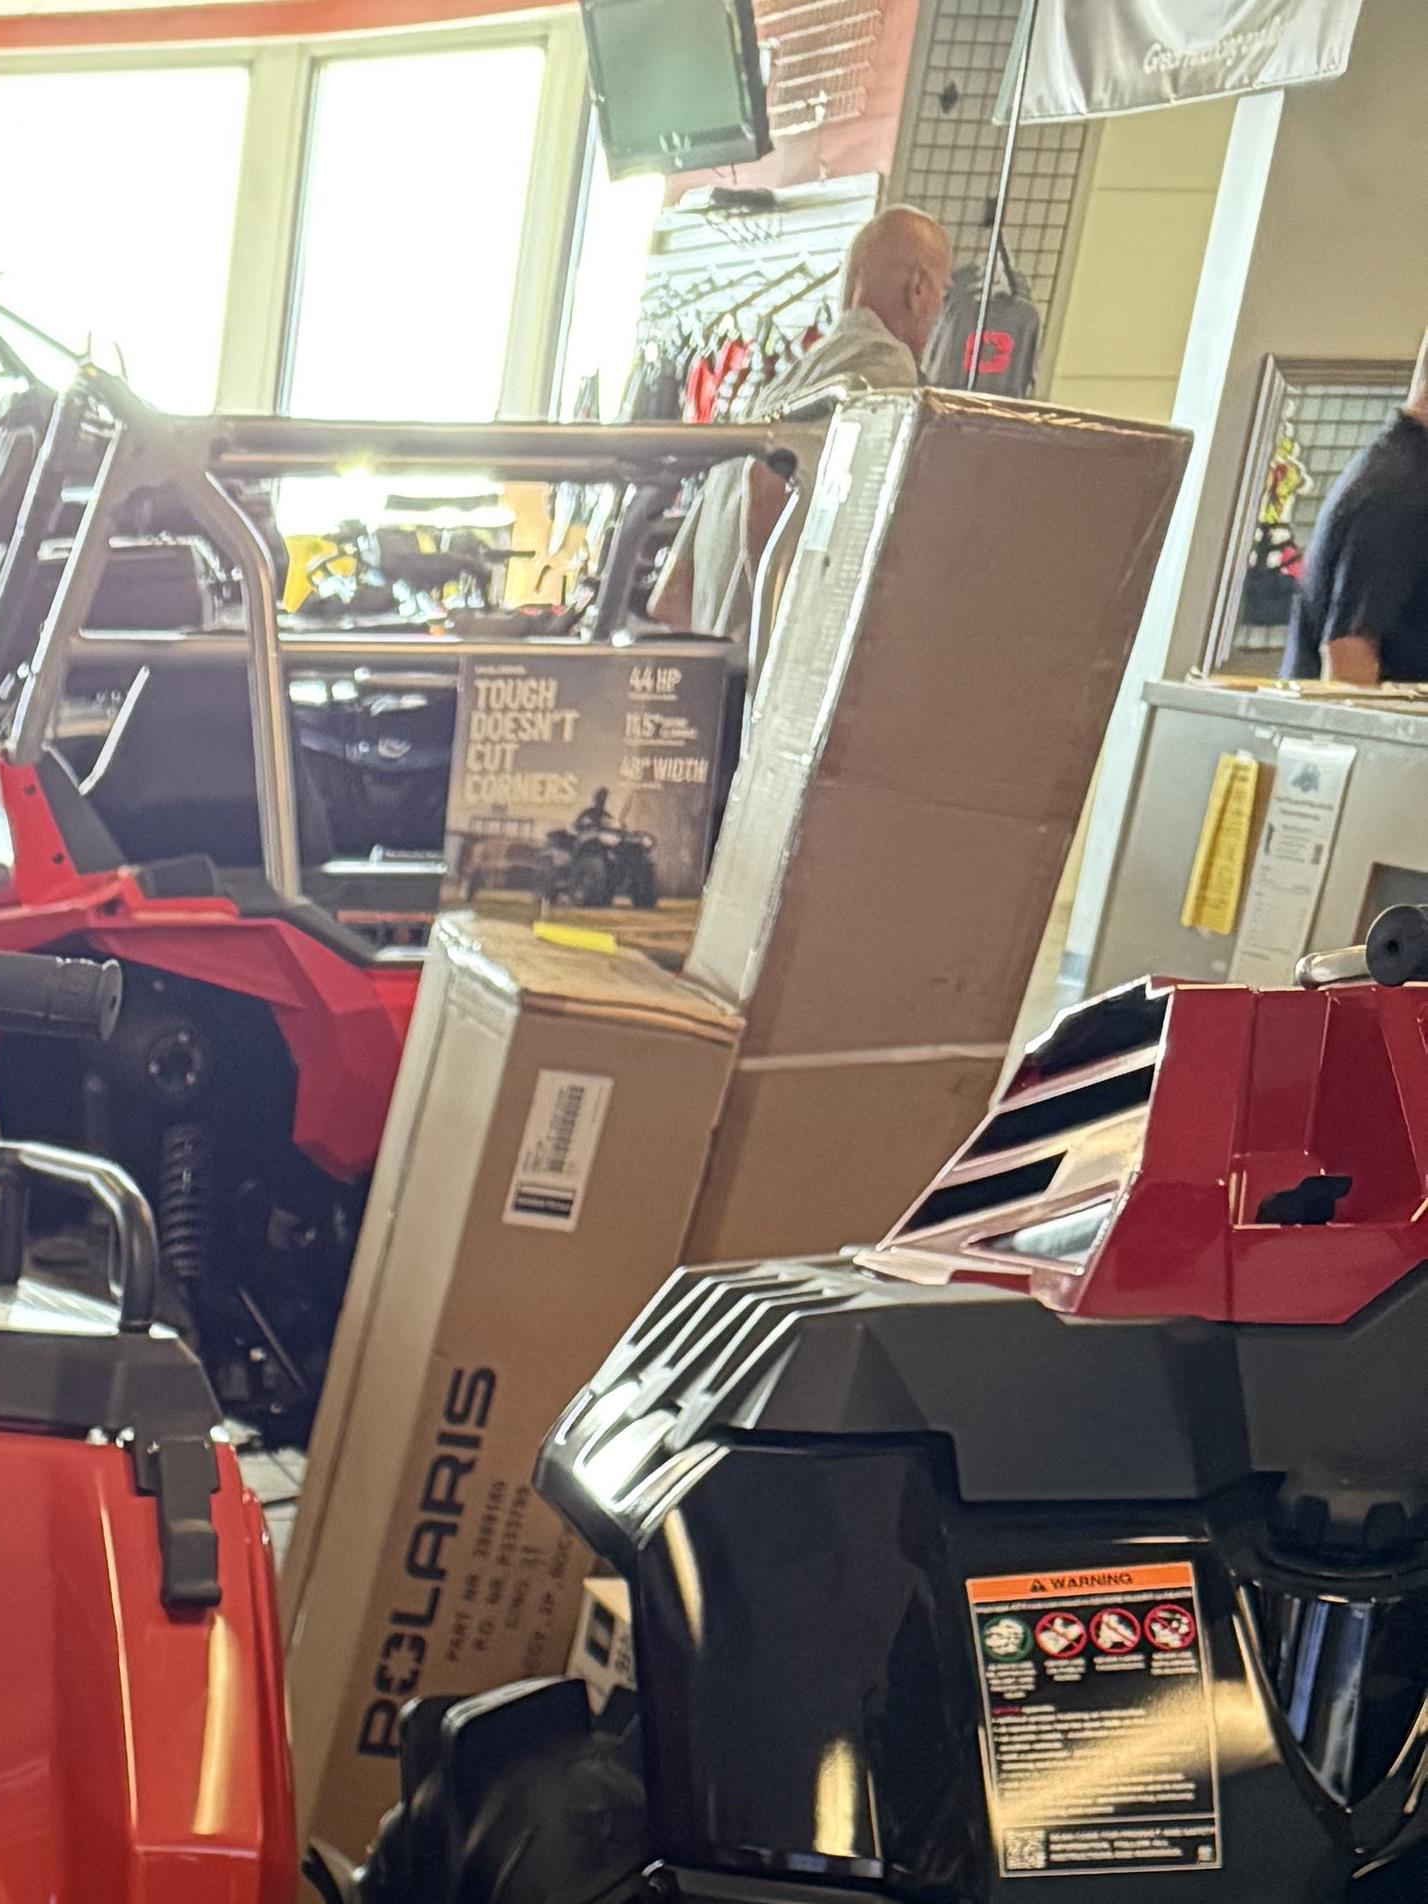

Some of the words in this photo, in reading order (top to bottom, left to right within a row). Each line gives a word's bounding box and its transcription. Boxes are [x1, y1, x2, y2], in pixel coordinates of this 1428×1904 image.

[474, 677, 557, 711] TOUGH
[629, 666, 654, 692] 44
[656, 667, 682, 693] HP
[470, 709, 580, 743] DOESN'T
[466, 741, 519, 773] CUT
[653, 757, 709, 783] WIDTH
[463, 774, 578, 801] CORNERS
[358, 1365, 496, 1761] POLARIS
[1050, 1572, 1134, 1591] WARNING
